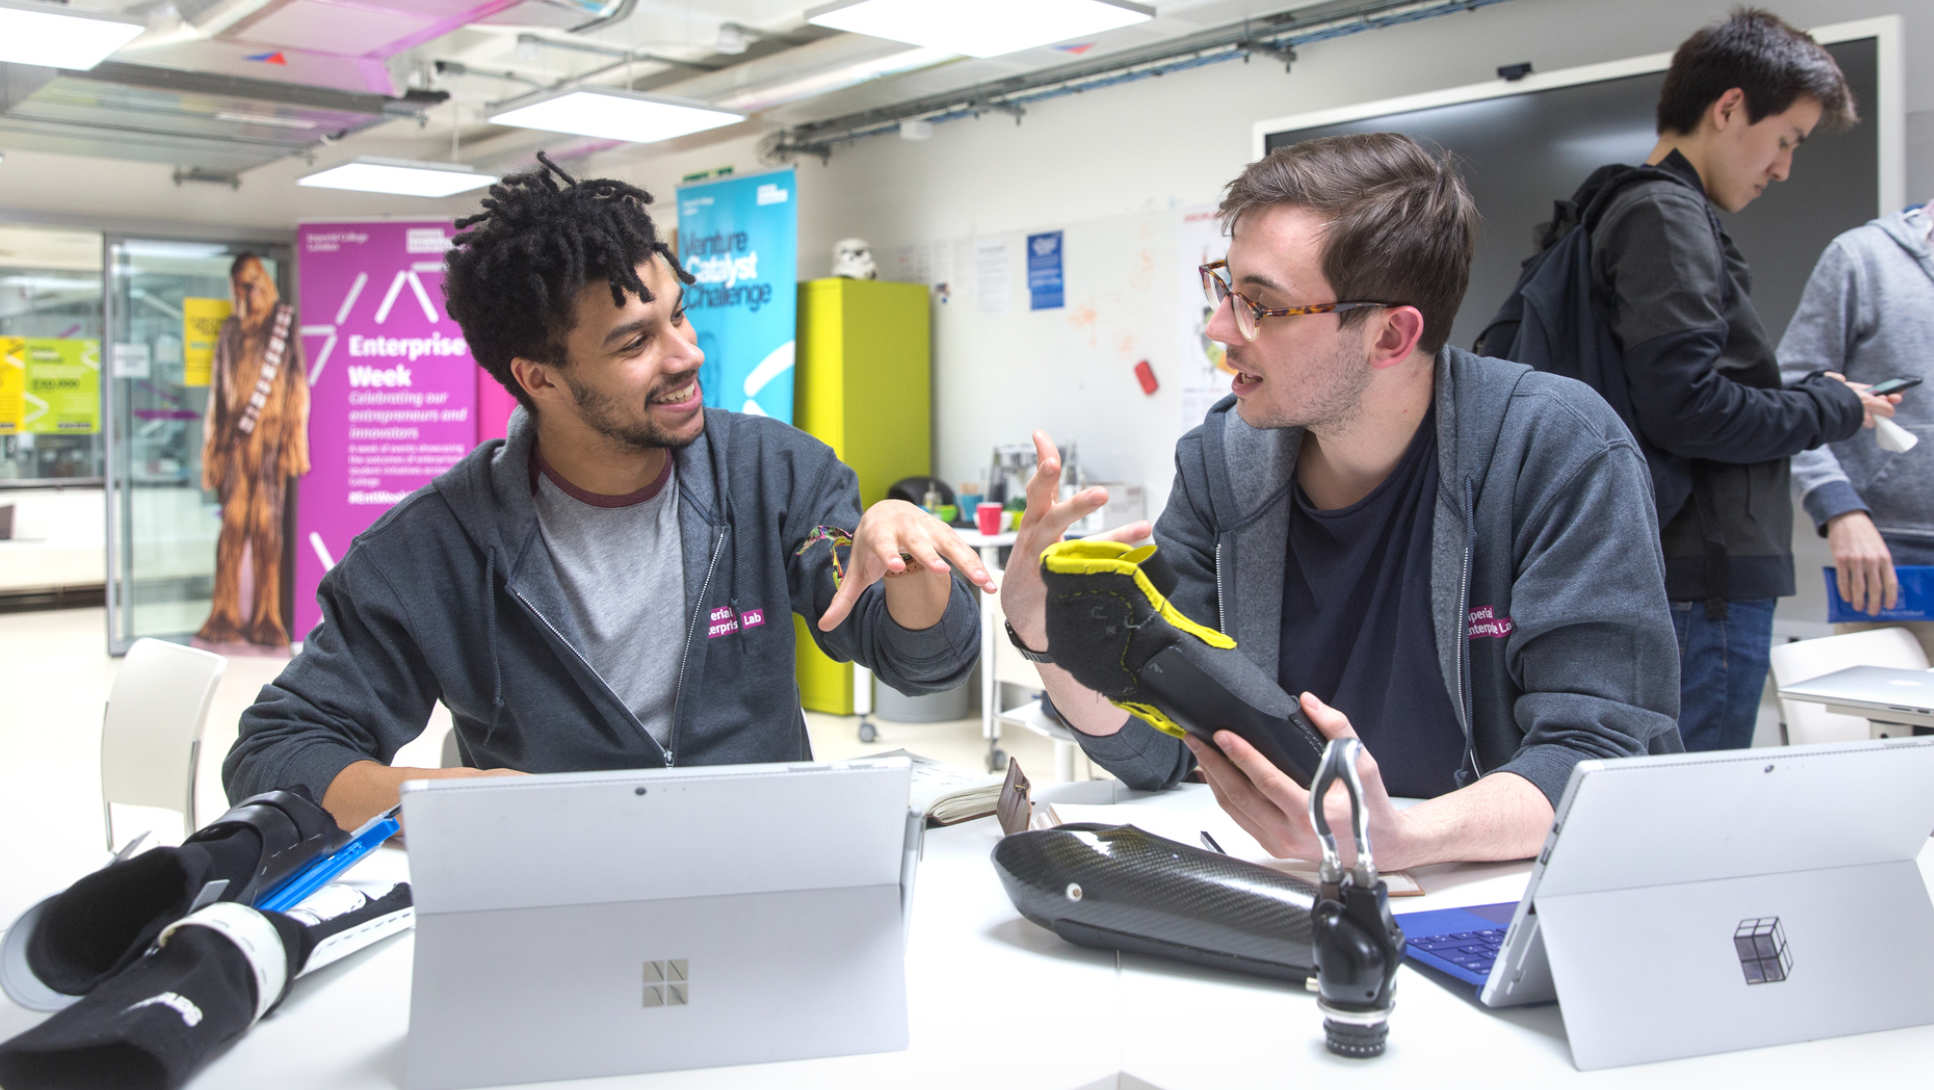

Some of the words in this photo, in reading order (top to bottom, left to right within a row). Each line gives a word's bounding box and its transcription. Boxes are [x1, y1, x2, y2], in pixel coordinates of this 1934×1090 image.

[683, 231, 749, 257] Venture
[686, 252, 758, 289] Catalyst
[685, 283, 773, 312] Challenge
[349, 331, 467, 361] Enterprise
[348, 364, 412, 387] Week
[349, 391, 423, 407] Celebrating
[425, 392, 449, 405] our
[349, 409, 439, 423] entrepreneurs
[441, 407, 468, 422] and
[349, 425, 419, 440] innovators
[743, 612, 761, 625] Lab
